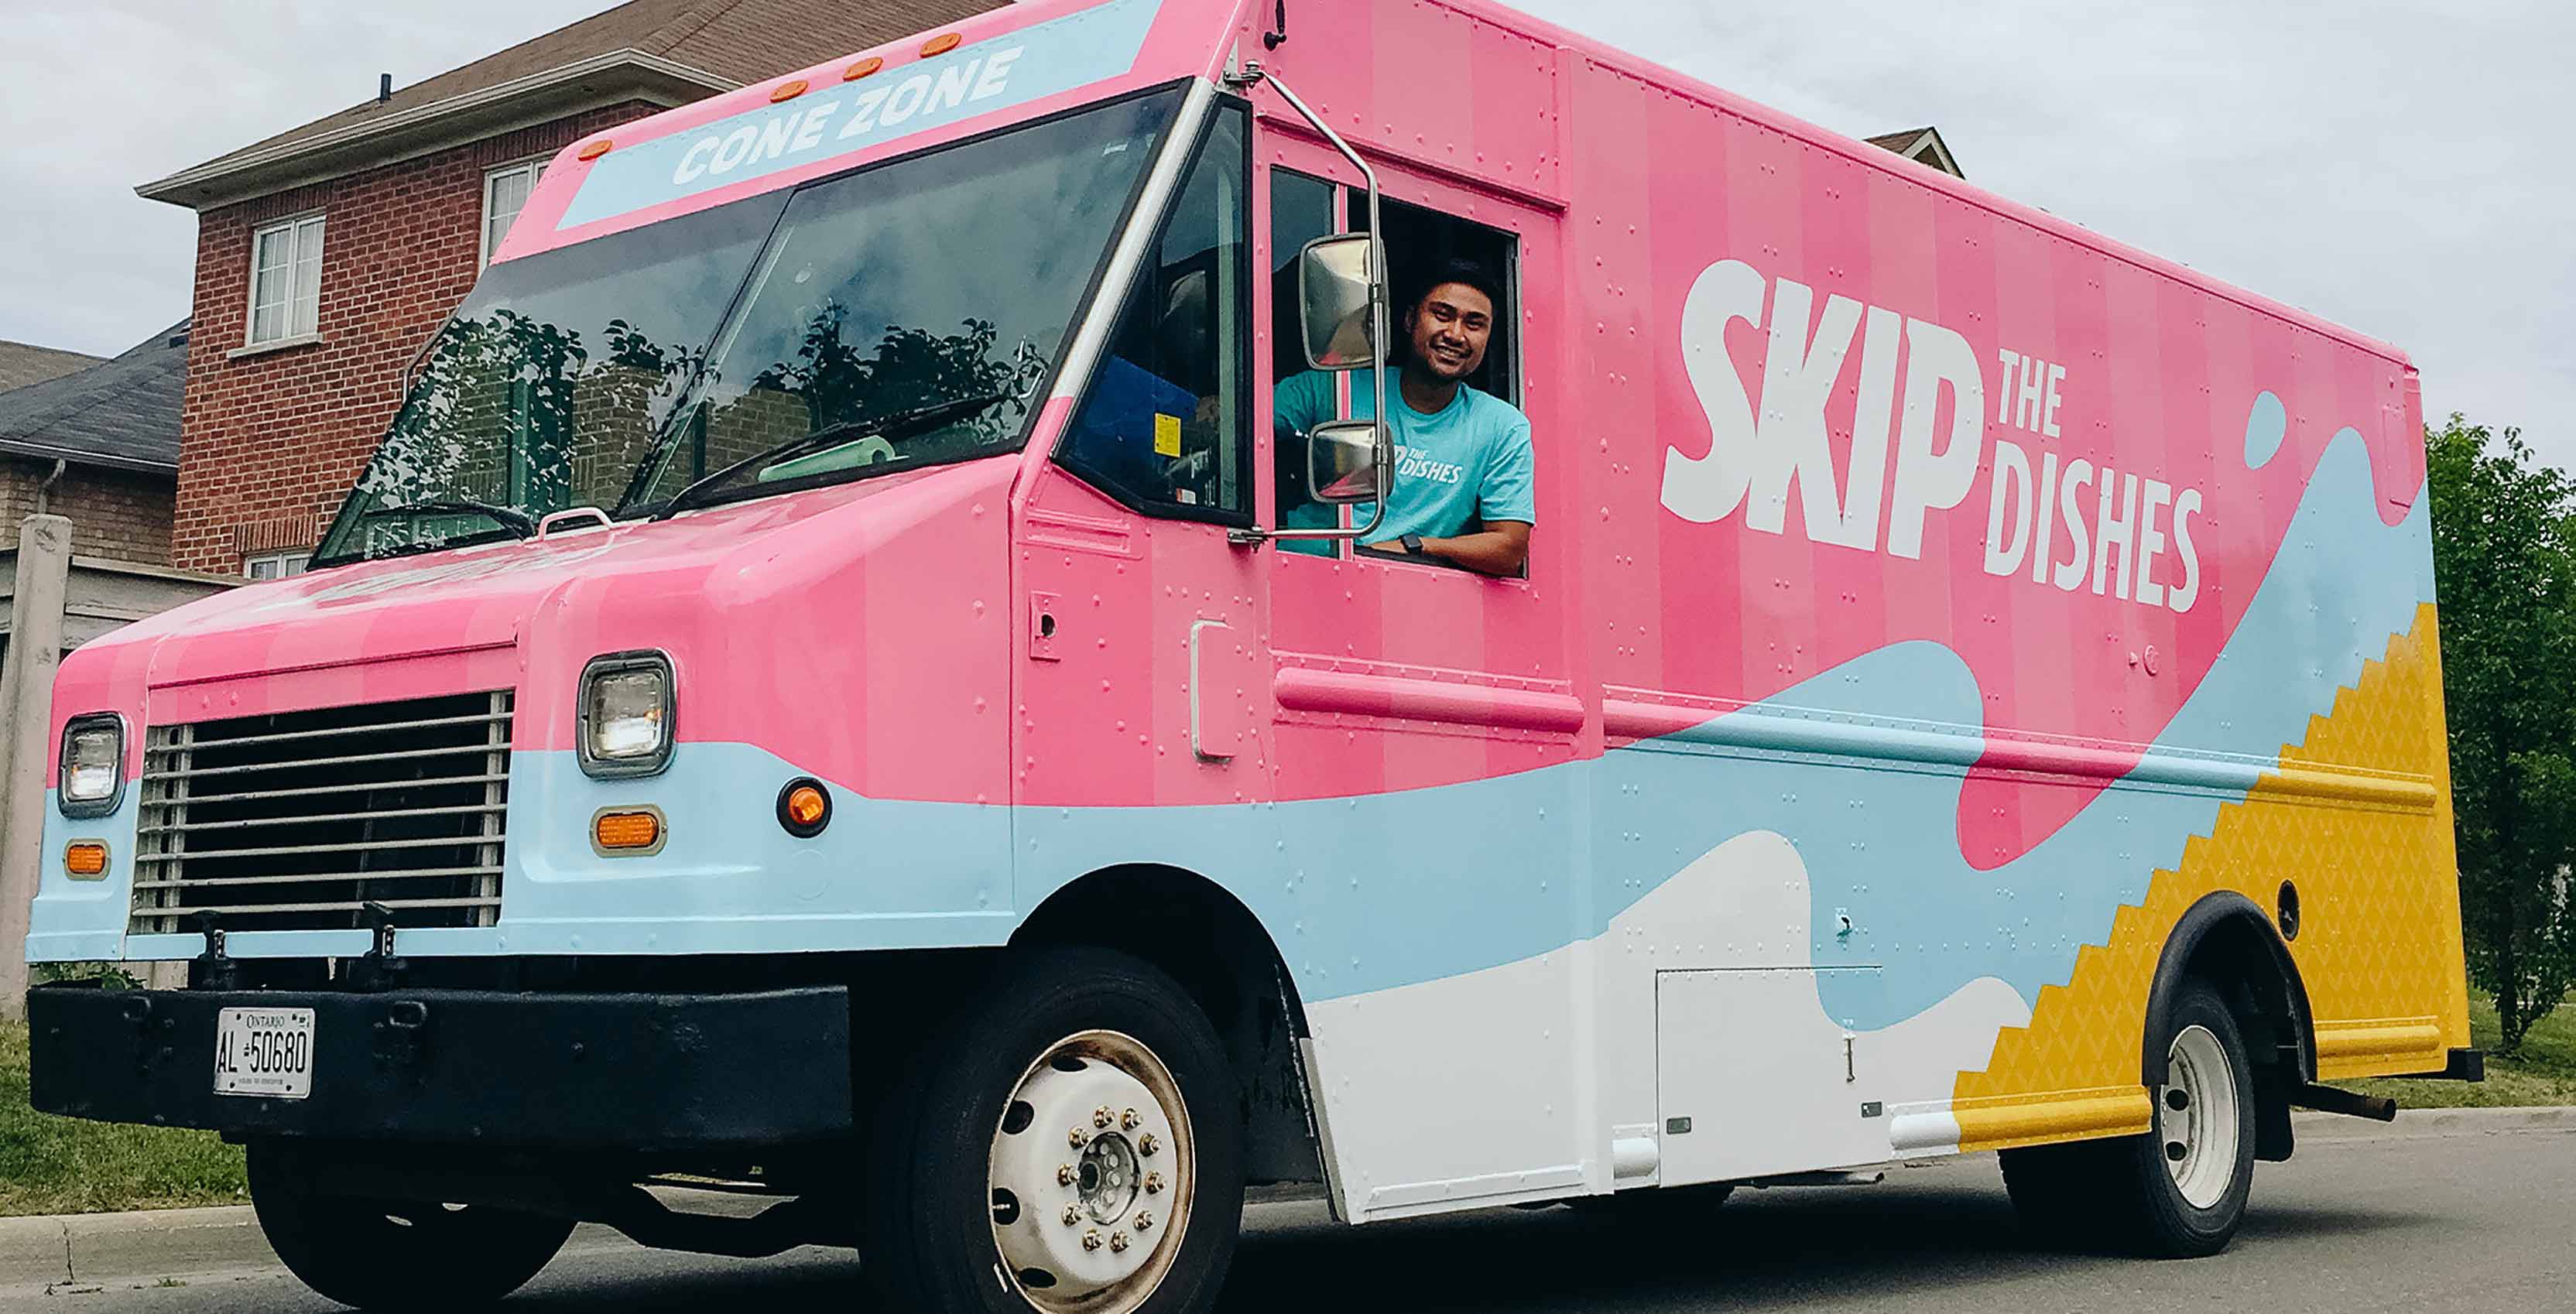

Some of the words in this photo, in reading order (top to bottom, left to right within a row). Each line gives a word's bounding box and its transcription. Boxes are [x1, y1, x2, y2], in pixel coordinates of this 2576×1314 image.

[673, 101, 841, 186] CONE
[837, 45, 1025, 140] ZONE
[1660, 258, 1985, 560] SKIP
[1999, 347, 2067, 438] THE
[1399, 458, 1462, 484] DISHES
[1409, 448, 1428, 458] THE
[1984, 440, 2203, 614] DISHES
[216, 1031, 238, 1073] AL
[249, 1031, 307, 1073] 50680
